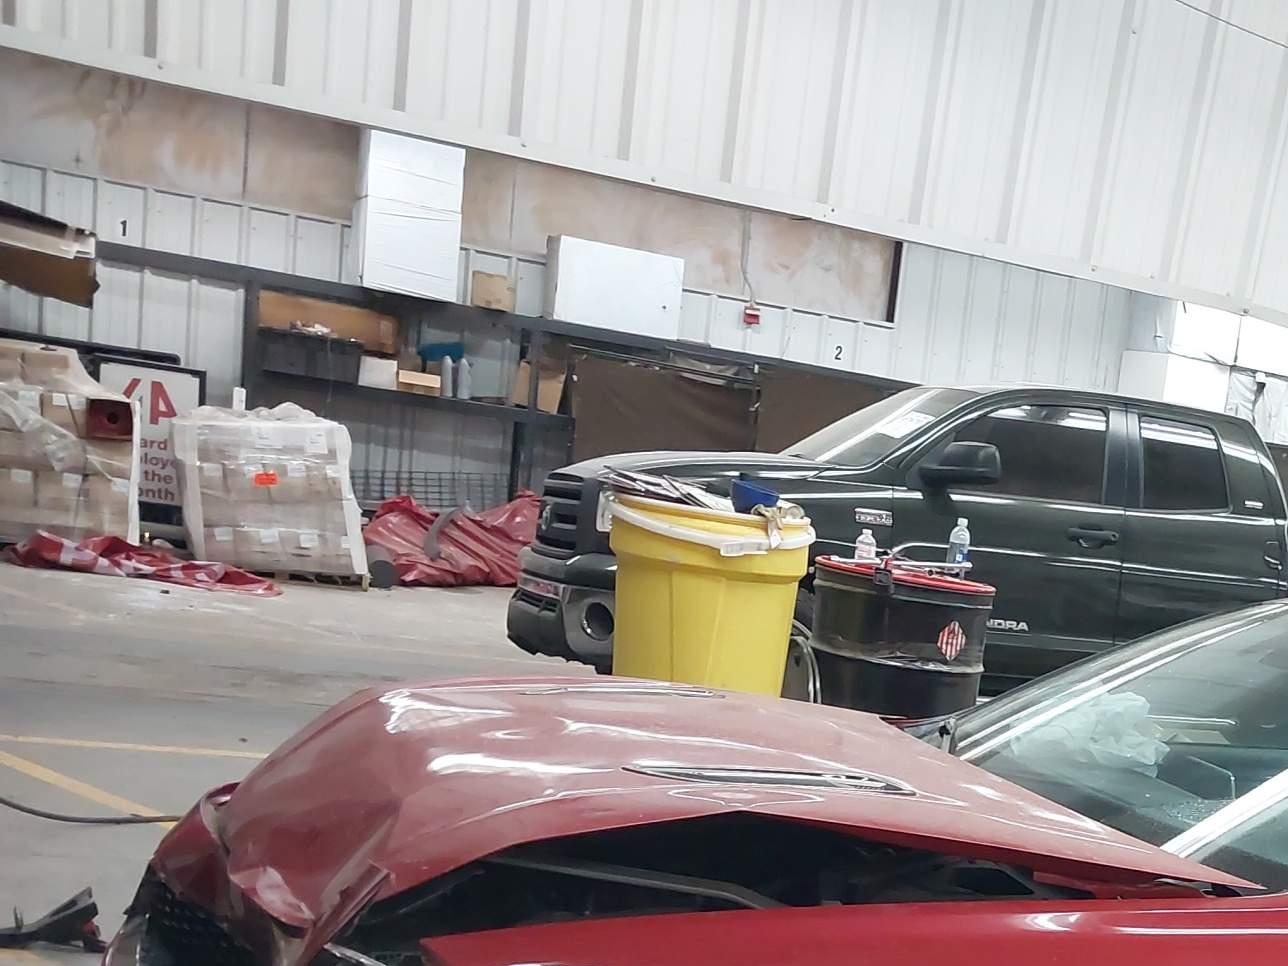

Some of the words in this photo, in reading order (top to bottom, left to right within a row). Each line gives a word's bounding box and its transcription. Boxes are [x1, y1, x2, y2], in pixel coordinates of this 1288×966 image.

[119, 219, 127, 237] 1
[834, 345, 843, 361] 2
[143, 469, 174, 485] the
